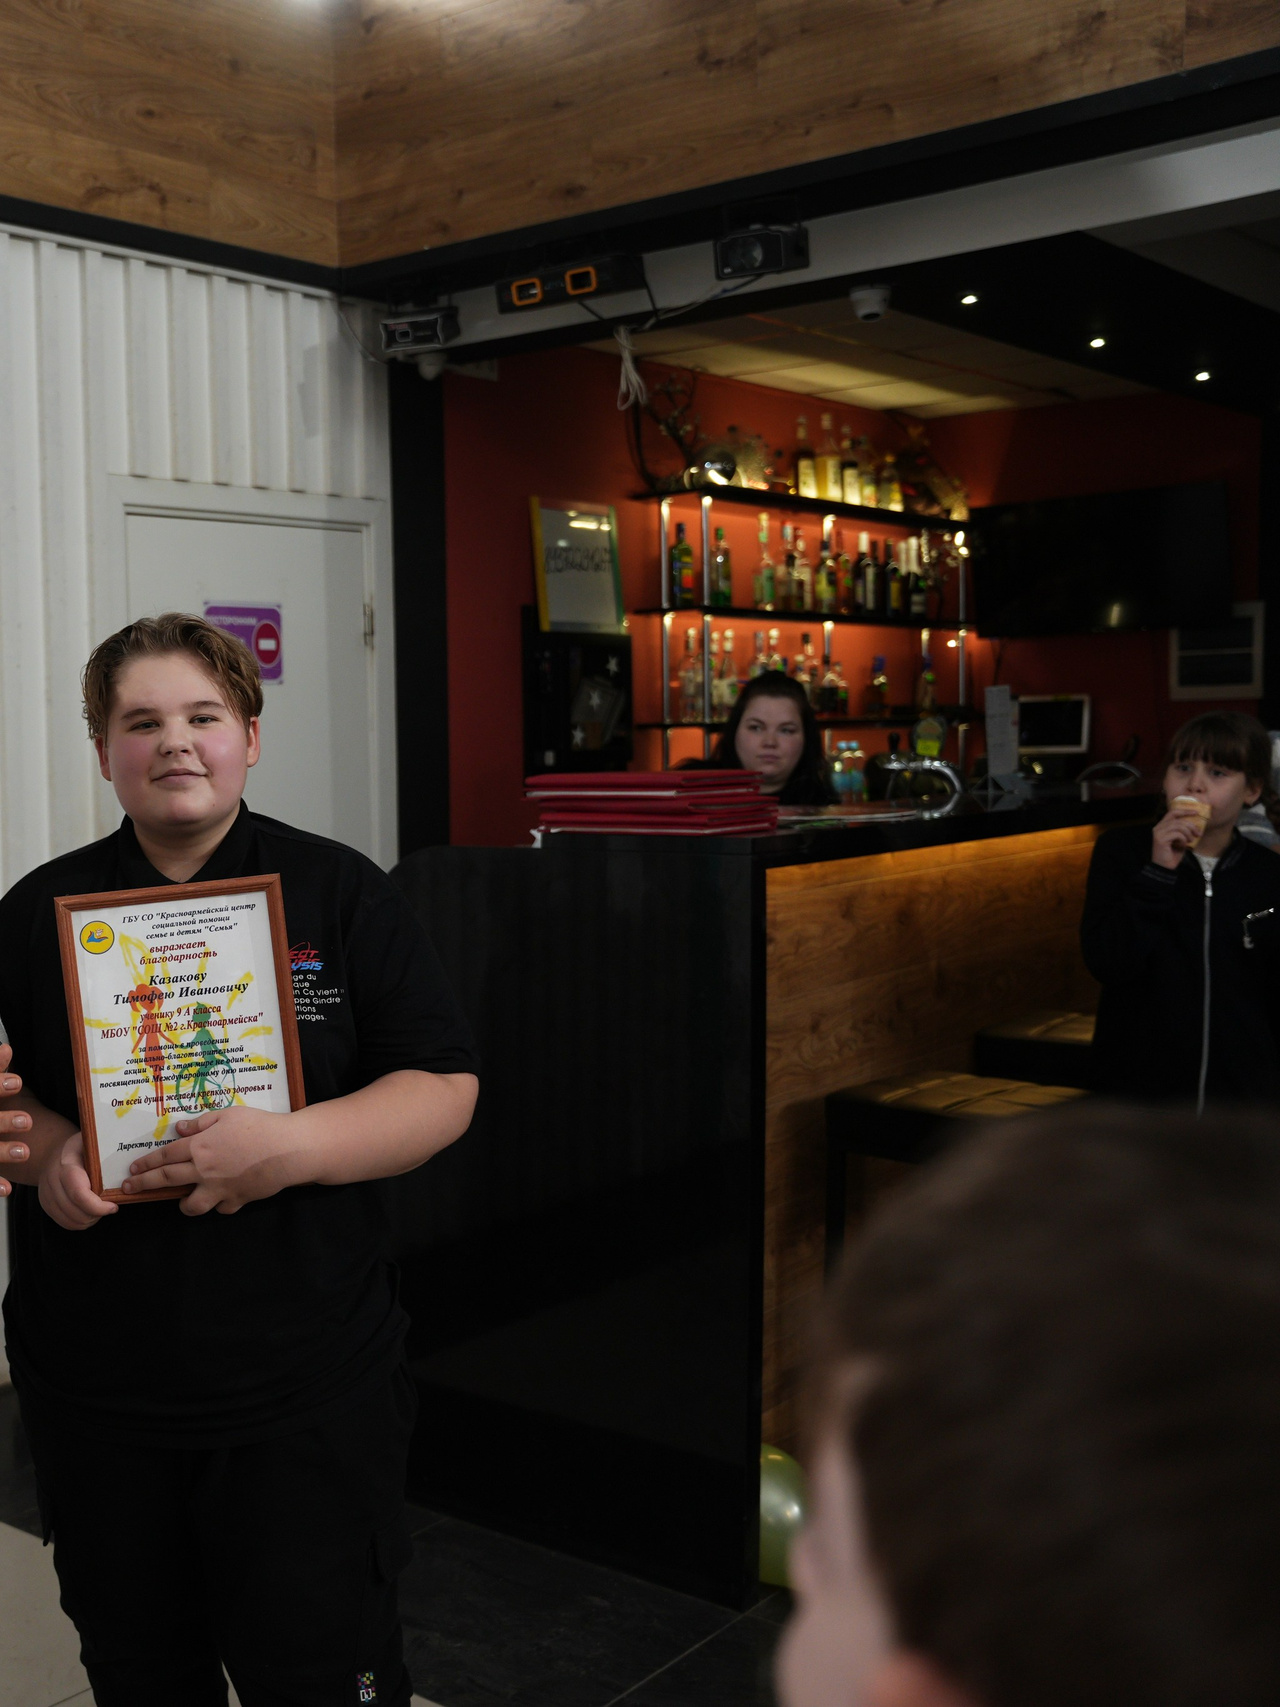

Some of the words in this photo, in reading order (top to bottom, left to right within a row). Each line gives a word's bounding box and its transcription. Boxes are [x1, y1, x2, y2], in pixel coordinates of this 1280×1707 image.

[151, 917, 196, 929] социальной
[197, 915, 230, 924] помощи
[145, 931, 168, 939] семье
[175, 928, 202, 936] детям
[149, 940, 206, 954] выражает
[139, 950, 217, 965] благодарность
[148, 972, 207, 986] Казакову
[112, 990, 175, 1005] Тимофею
[178, 982, 248, 997] Ивановичу
[139, 1010, 175, 1023] ученику
[176, 1006, 182, 1017] 9
[183, 1006, 190, 1016] А
[192, 1005, 221, 1015] класса
[100, 1026, 130, 1039] МБОУ
[121, 914, 139, 923] ГБУ
[140, 913, 154, 921] СО
[154, 1139, 177, 1148] цент
[148, 1043, 179, 1051] помощь
[185, 1037, 229, 1049] проведении
[123, 1067, 147, 1075] акции
[172, 1061, 193, 1070] этом
[192, 1059, 213, 1068] мире
[99, 1075, 149, 1088] посвященной
[151, 1067, 220, 1082] Международному
[220, 1065, 237, 1075] дню
[238, 1062, 278, 1073] инвалидов
[110, 1097, 124, 1107] От
[125, 1095, 142, 1106] всей
[143, 1094, 164, 1105] души
[165, 1090, 197, 1101] желаем
[196, 1087, 231, 1100] крепкого
[231, 1084, 265, 1096] здоровья
[161, 1103, 194, 1116] успехов
[198, 1098, 223, 1112] учебе!
[116, 1140, 153, 1151] Директор
[154, 1139, 177, 1148] цент
